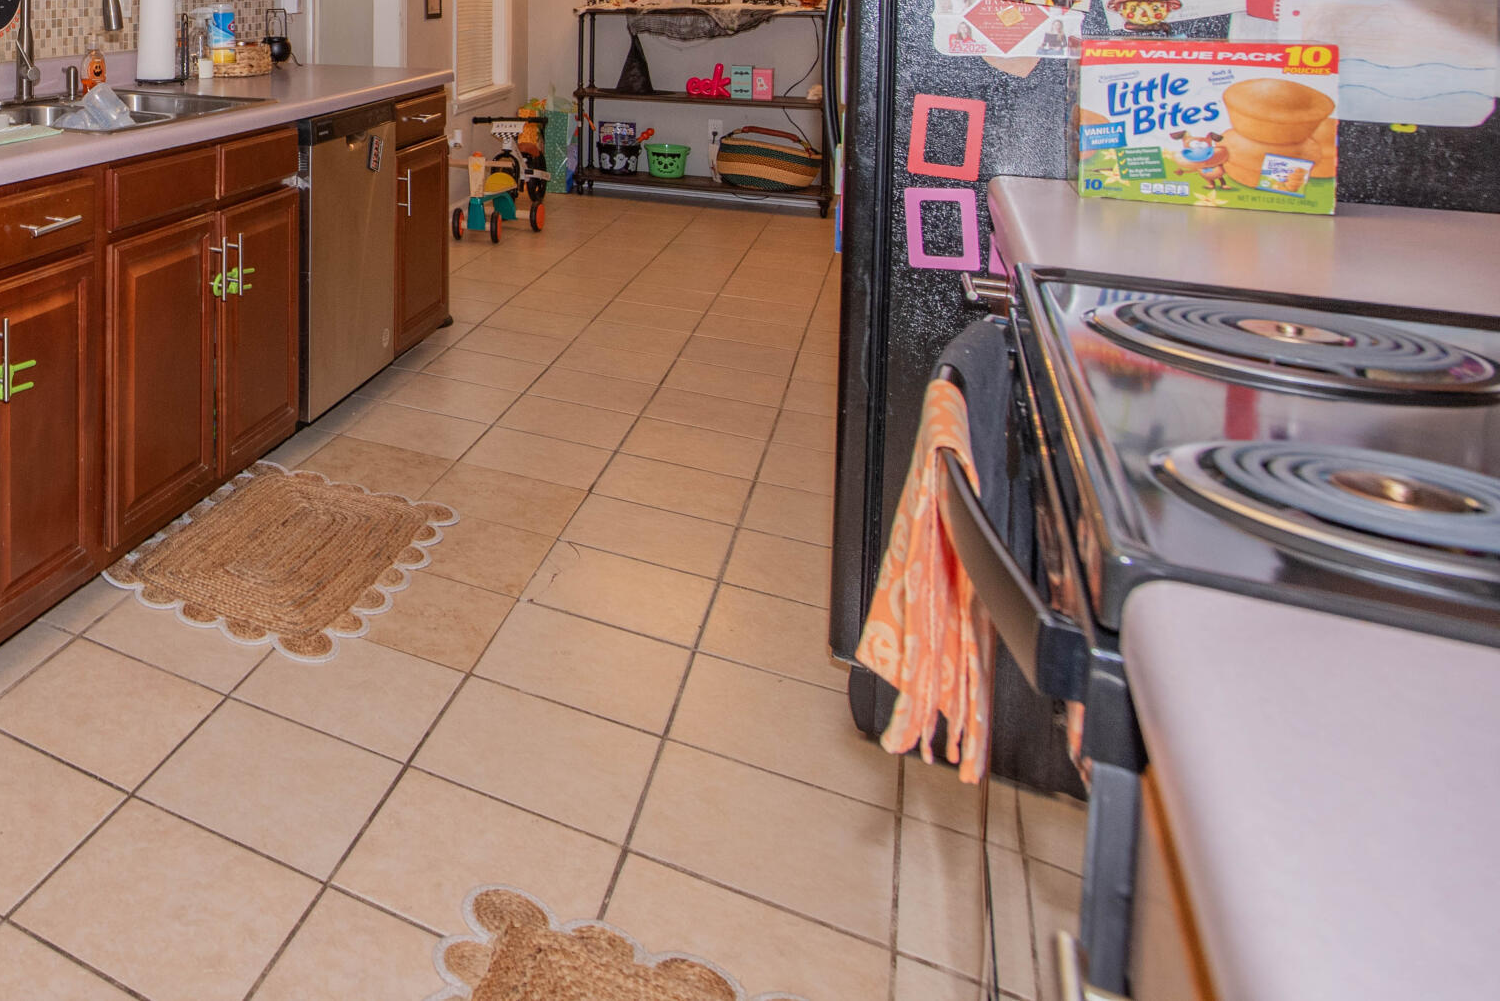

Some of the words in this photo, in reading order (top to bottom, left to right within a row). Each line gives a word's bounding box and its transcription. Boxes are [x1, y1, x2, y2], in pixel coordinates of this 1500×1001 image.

[1085, 48, 1137, 58] NEW
[1139, 50, 1214, 60] VALUE
[1217, 52, 1284, 62] PACK
[1285, 46, 1333, 67] 10
[1283, 67, 1331, 75] POUCHES
[686, 63, 731, 97] eek
[1108, 72, 1190, 117] Little
[1133, 102, 1220, 135] Bites
[1084, 125, 1124, 136] VANILLA
[1091, 137, 1119, 146] MUFFINS
[1084, 178, 1103, 190] 10
